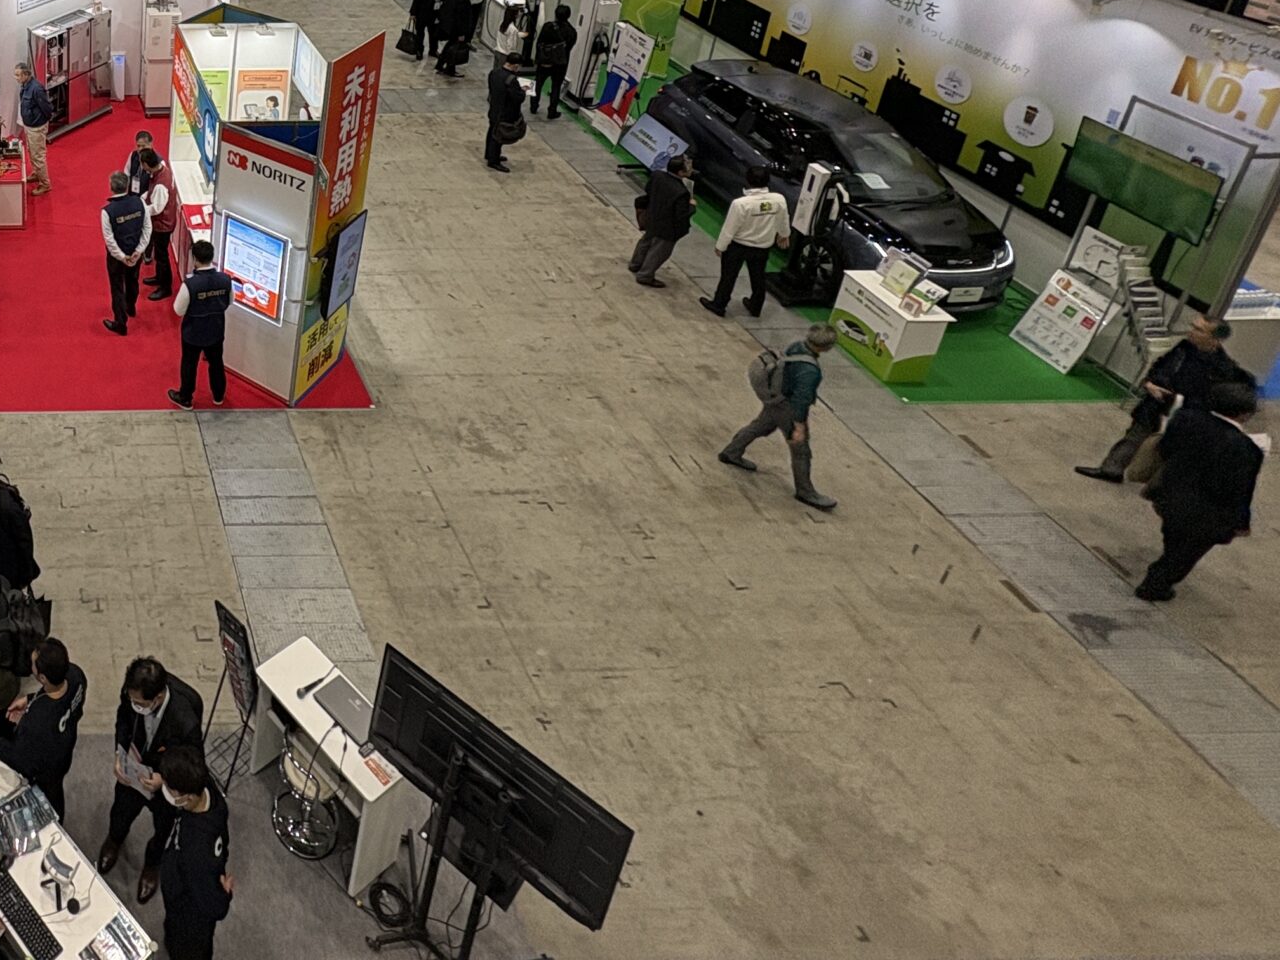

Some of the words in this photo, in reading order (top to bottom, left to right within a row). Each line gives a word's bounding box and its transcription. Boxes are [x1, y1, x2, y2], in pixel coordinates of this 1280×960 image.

[250, 160, 306, 192] NORITZ
[329, 65, 366, 218] 未利用熱
